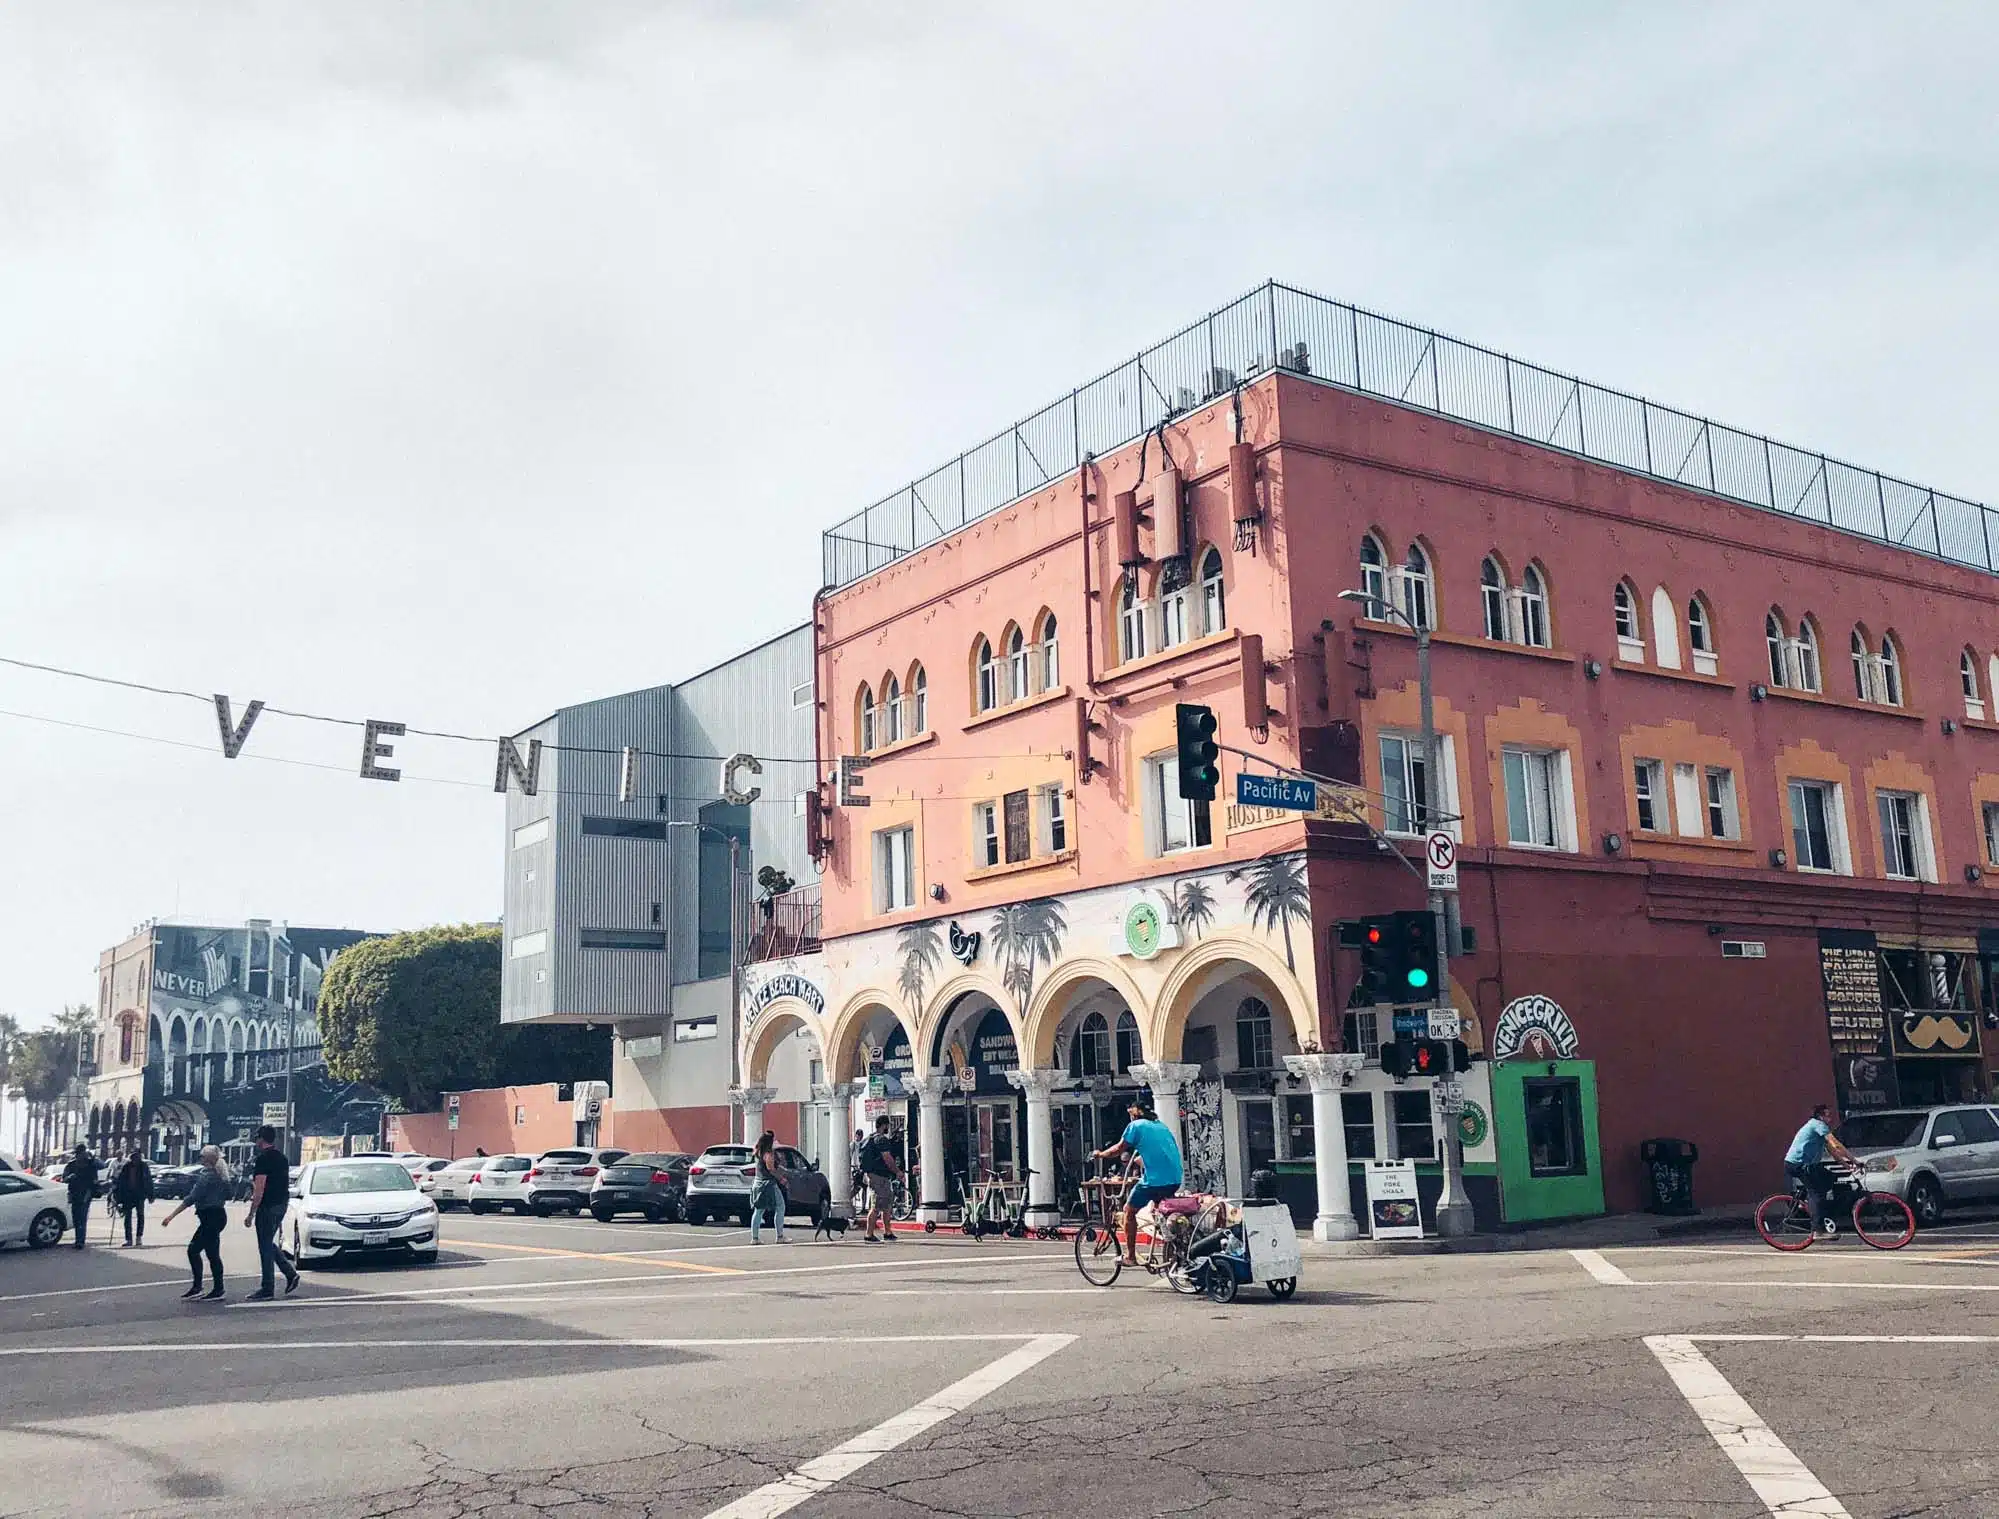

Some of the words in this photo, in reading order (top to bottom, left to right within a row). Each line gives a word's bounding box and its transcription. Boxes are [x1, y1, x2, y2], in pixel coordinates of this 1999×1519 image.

[214, 694, 871, 807] VENICE
[1243, 779, 1290, 801] Pacific
[1294, 786, 1310, 803] Av
[769, 975, 797, 998] BEACH
[798, 979, 823, 1014] MART
[979, 1034, 1015, 1049] SANDWI
[1430, 1024, 1443, 1036] OK
